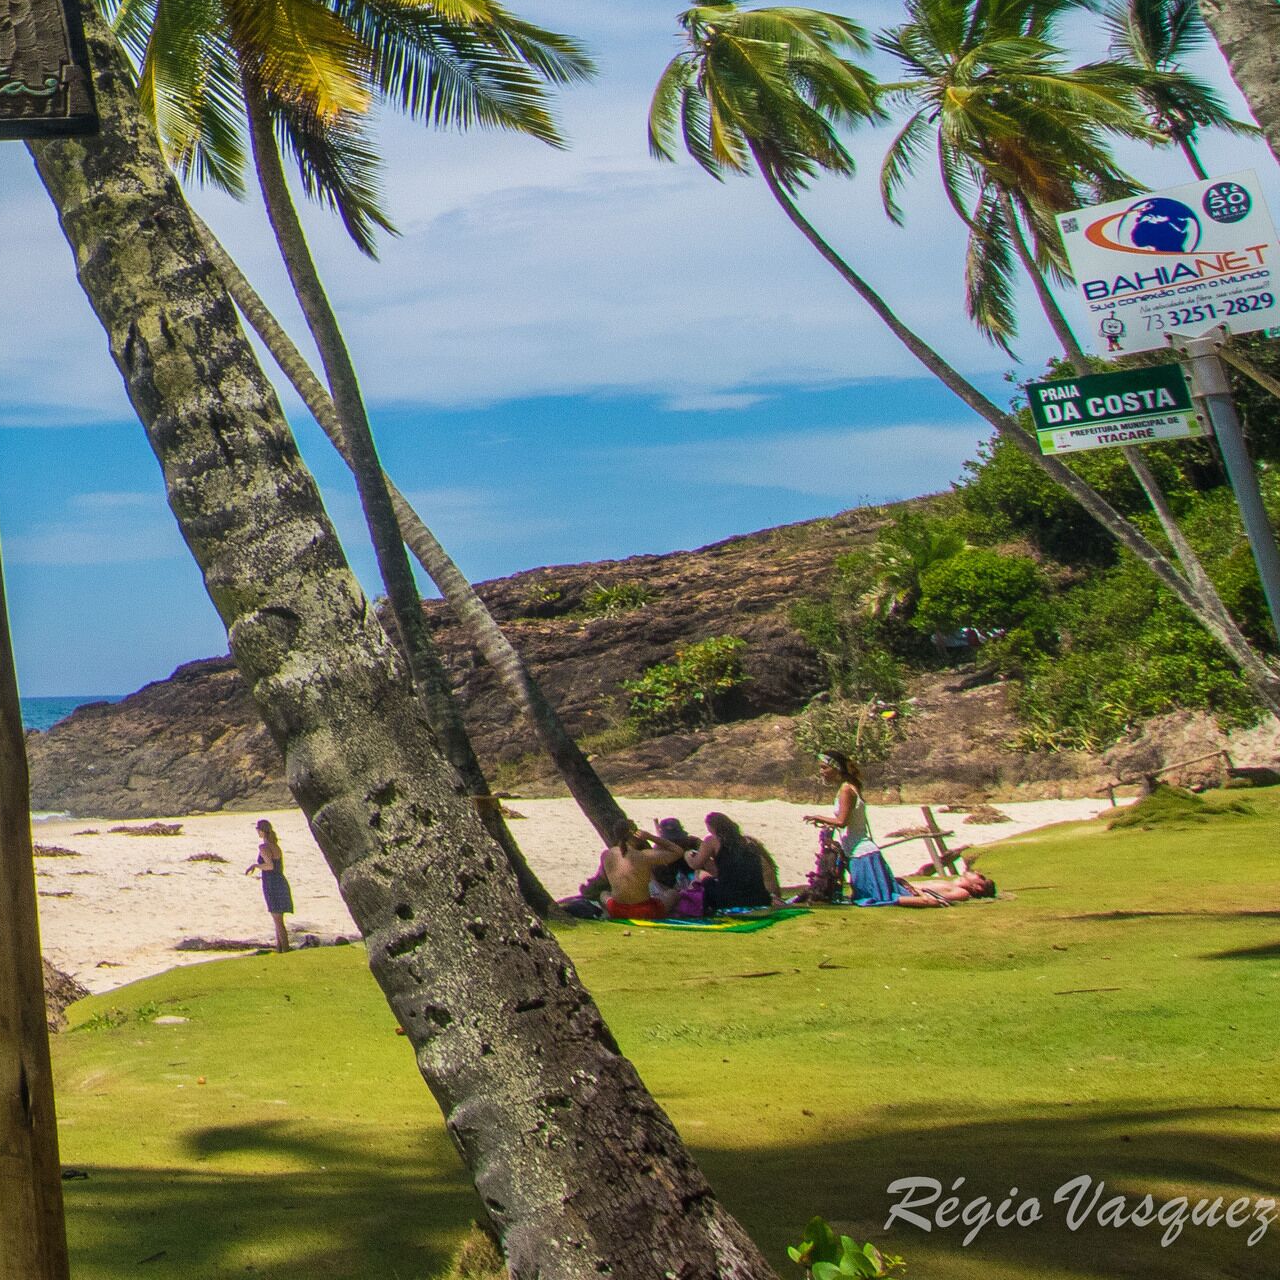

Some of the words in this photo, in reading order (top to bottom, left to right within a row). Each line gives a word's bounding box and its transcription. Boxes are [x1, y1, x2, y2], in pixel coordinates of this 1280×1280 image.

[1209, 192, 1245, 209] 50
[1082, 244, 1269, 301] BAHIANET
[1090, 302, 1116, 313] Sua
[1118, 289, 1175, 307] conexão
[1177, 283, 1207, 295] com
[1209, 280, 1218, 288] o
[1220, 270, 1270, 286] Mundo
[1142, 313, 1166, 331] 73
[1167, 292, 1275, 326] 3251-2829
[1039, 384, 1081, 402] PRAIA
[1042, 402, 1083, 424] DA
[1085, 387, 1177, 417] COSTA
[1069, 424, 1119, 437] PREFEITURA
[1120, 419, 1167, 431] MUNICIPAL
[1167, 416, 1180, 424] DE
